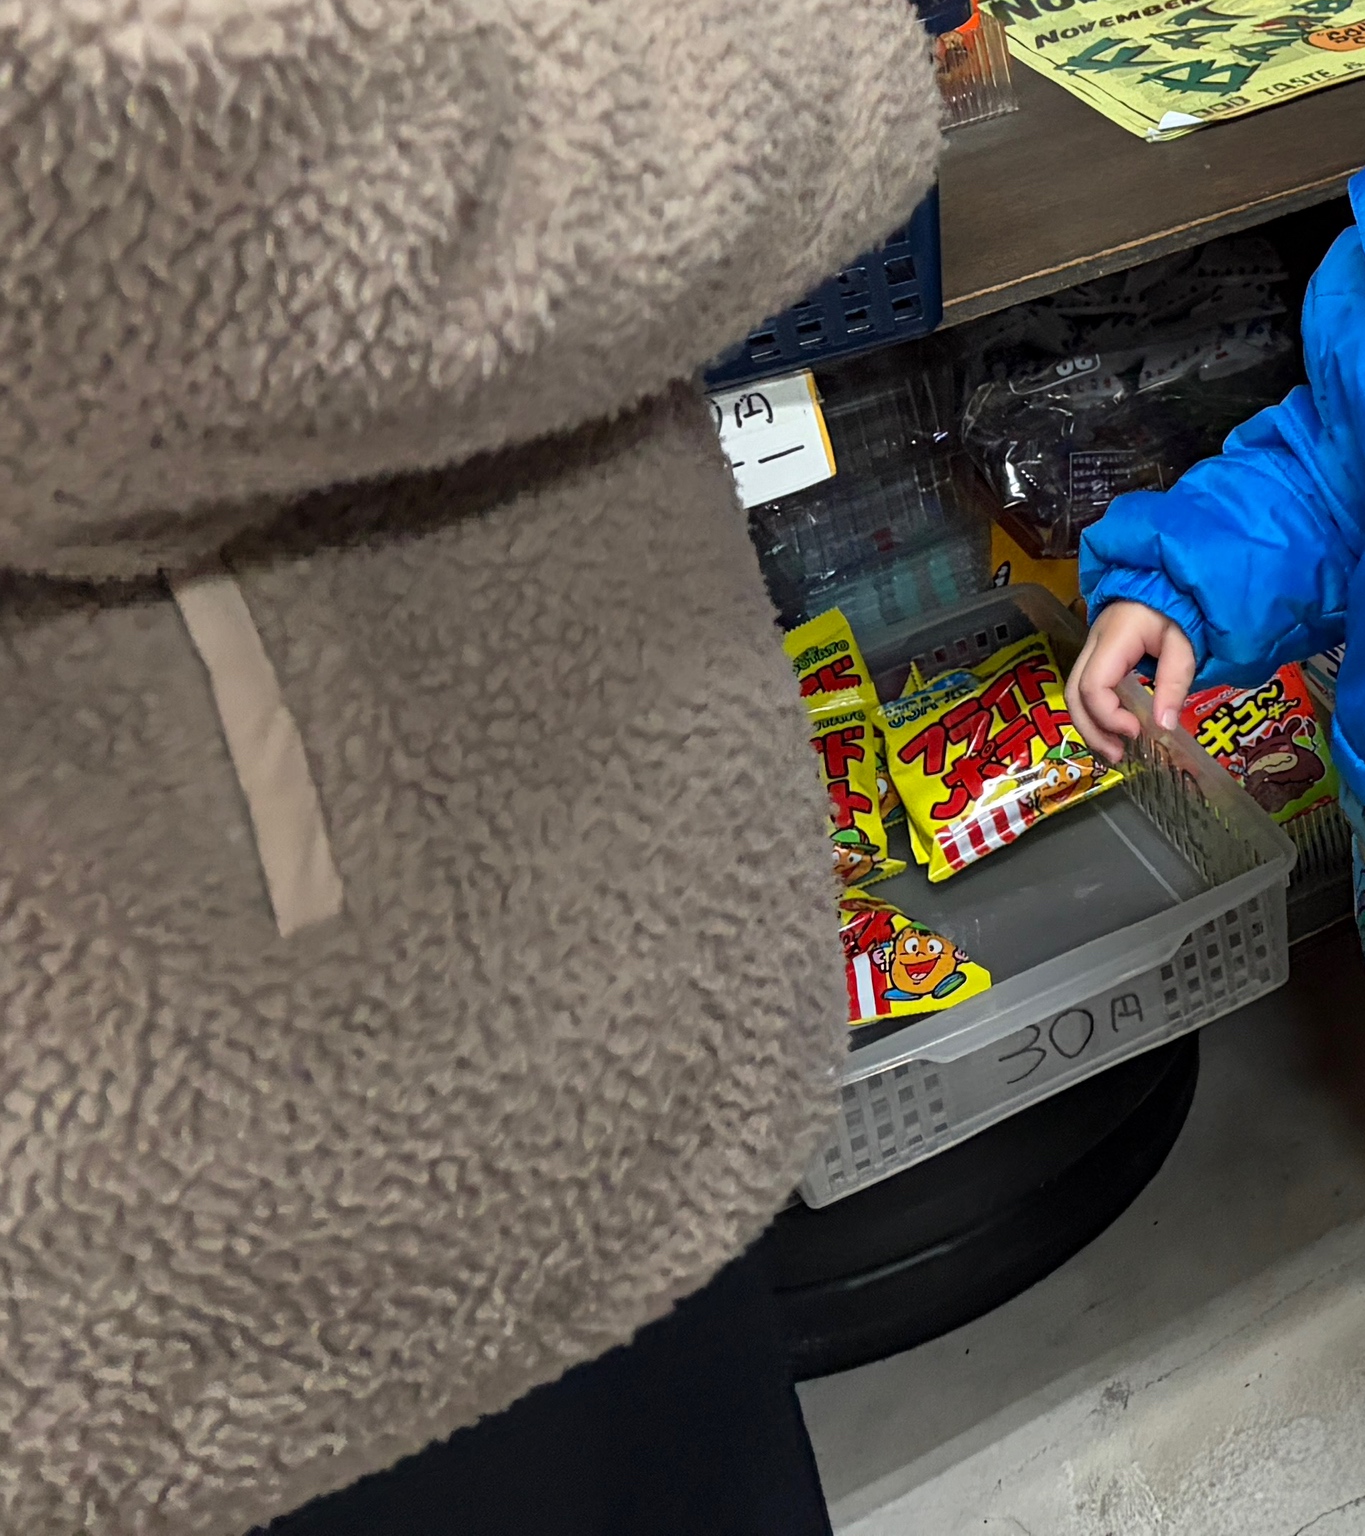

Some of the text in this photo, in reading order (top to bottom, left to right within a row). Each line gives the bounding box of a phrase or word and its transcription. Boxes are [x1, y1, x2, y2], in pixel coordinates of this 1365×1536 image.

[1257, 68, 1337, 96] TASTE
[897, 653, 1058, 777] フライド
[929, 701, 1074, 821] ポテト
[998, 991, 1144, 1086] 30円
